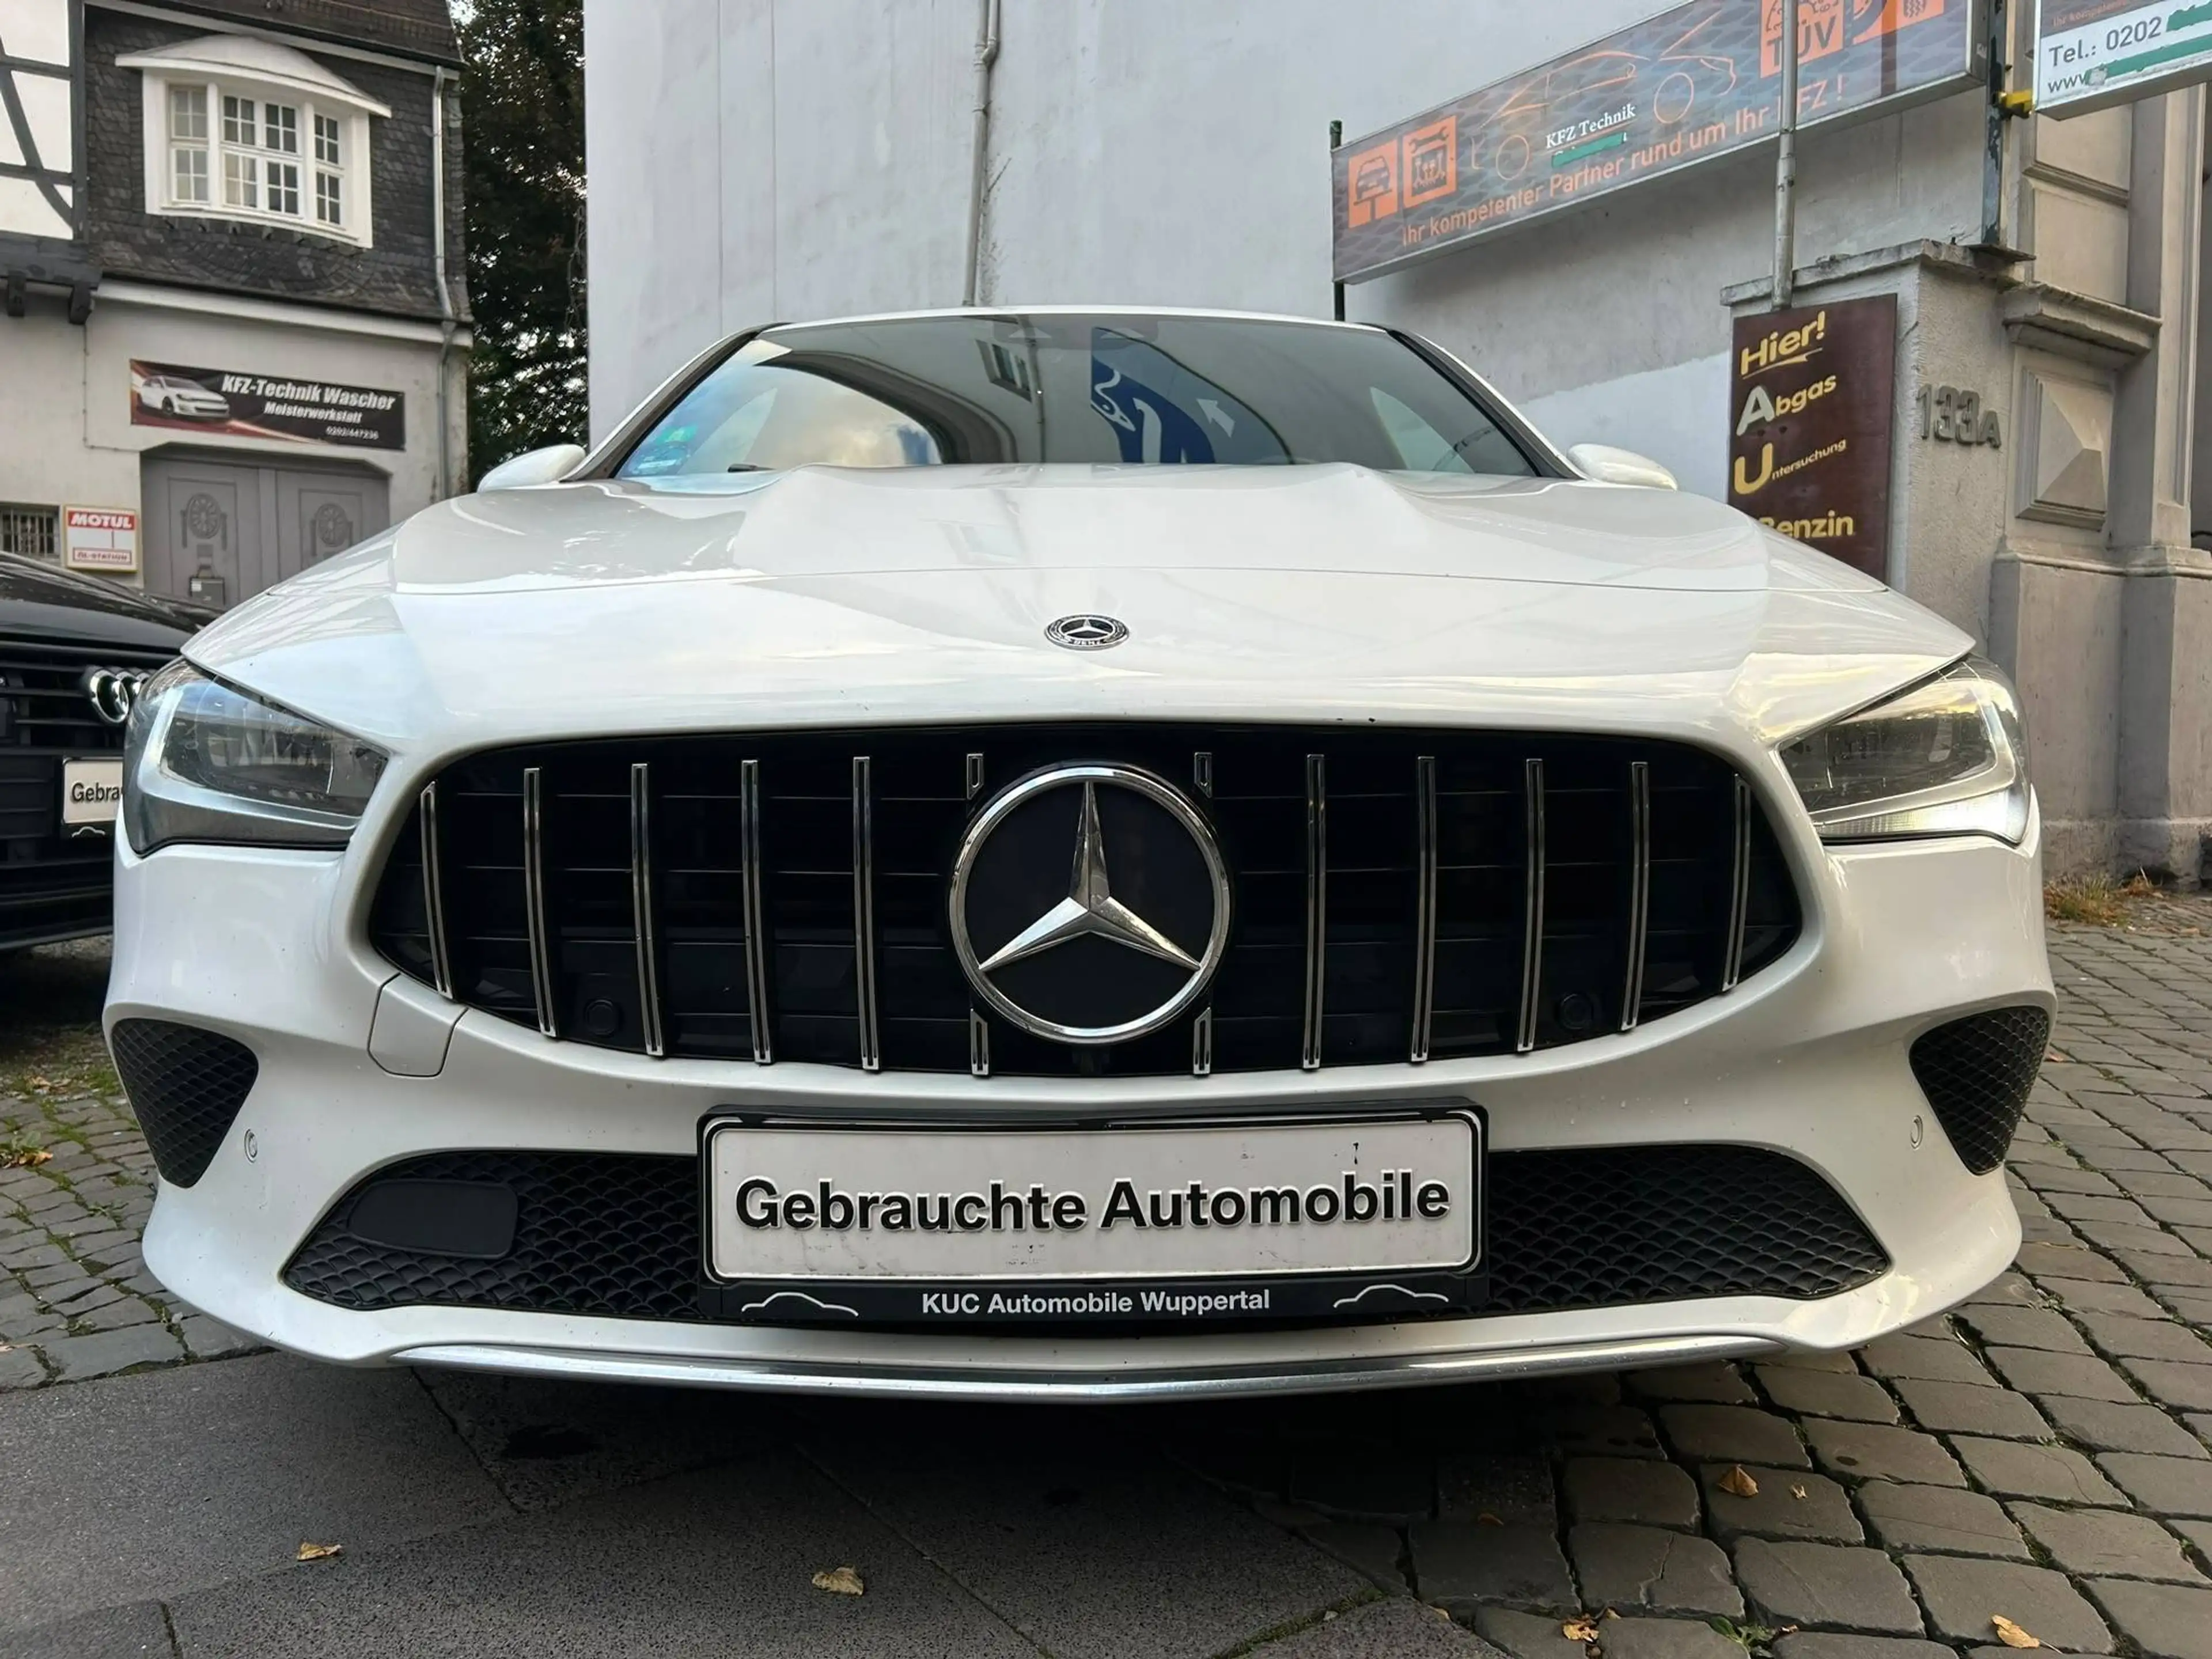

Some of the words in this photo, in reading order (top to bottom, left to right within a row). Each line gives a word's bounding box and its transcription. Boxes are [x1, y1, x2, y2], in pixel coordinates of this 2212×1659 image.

[2049, 39, 2096, 66] Tel.:
[2106, 16, 2162, 51] 0202
[2048, 73, 2086, 93] www
[1546, 126, 1575, 149] KFZ
[1578, 103, 1636, 137] Technik
[1403, 225, 1425, 247] Ihr
[1430, 185, 1543, 237] kompetenter
[1549, 156, 1624, 198] Partner
[1631, 132, 1681, 170] rund
[1690, 122, 1726, 149] um
[1736, 105, 1770, 135] Ihr
[1740, 311, 1825, 376] Hier!
[221, 373, 323, 402] KFZ-Technik
[323, 387, 396, 410] Wascher
[263, 402, 363, 423] Meisterwerkstatt
[1736, 374, 1836, 436] Abgas
[1915, 384, 2002, 449] 133A
[1734, 438, 1847, 495] Untersuchung
[71, 512, 132, 528] MOTUL
[71, 782, 123, 803] Gebra
[736, 1176, 1087, 1231] Gebrauchte
[1099, 1169, 1450, 1229] Automobile
[922, 1293, 980, 1314] KUC
[987, 1291, 1132, 1314] Automobile
[1140, 1289, 1271, 1316] Wuppertal
